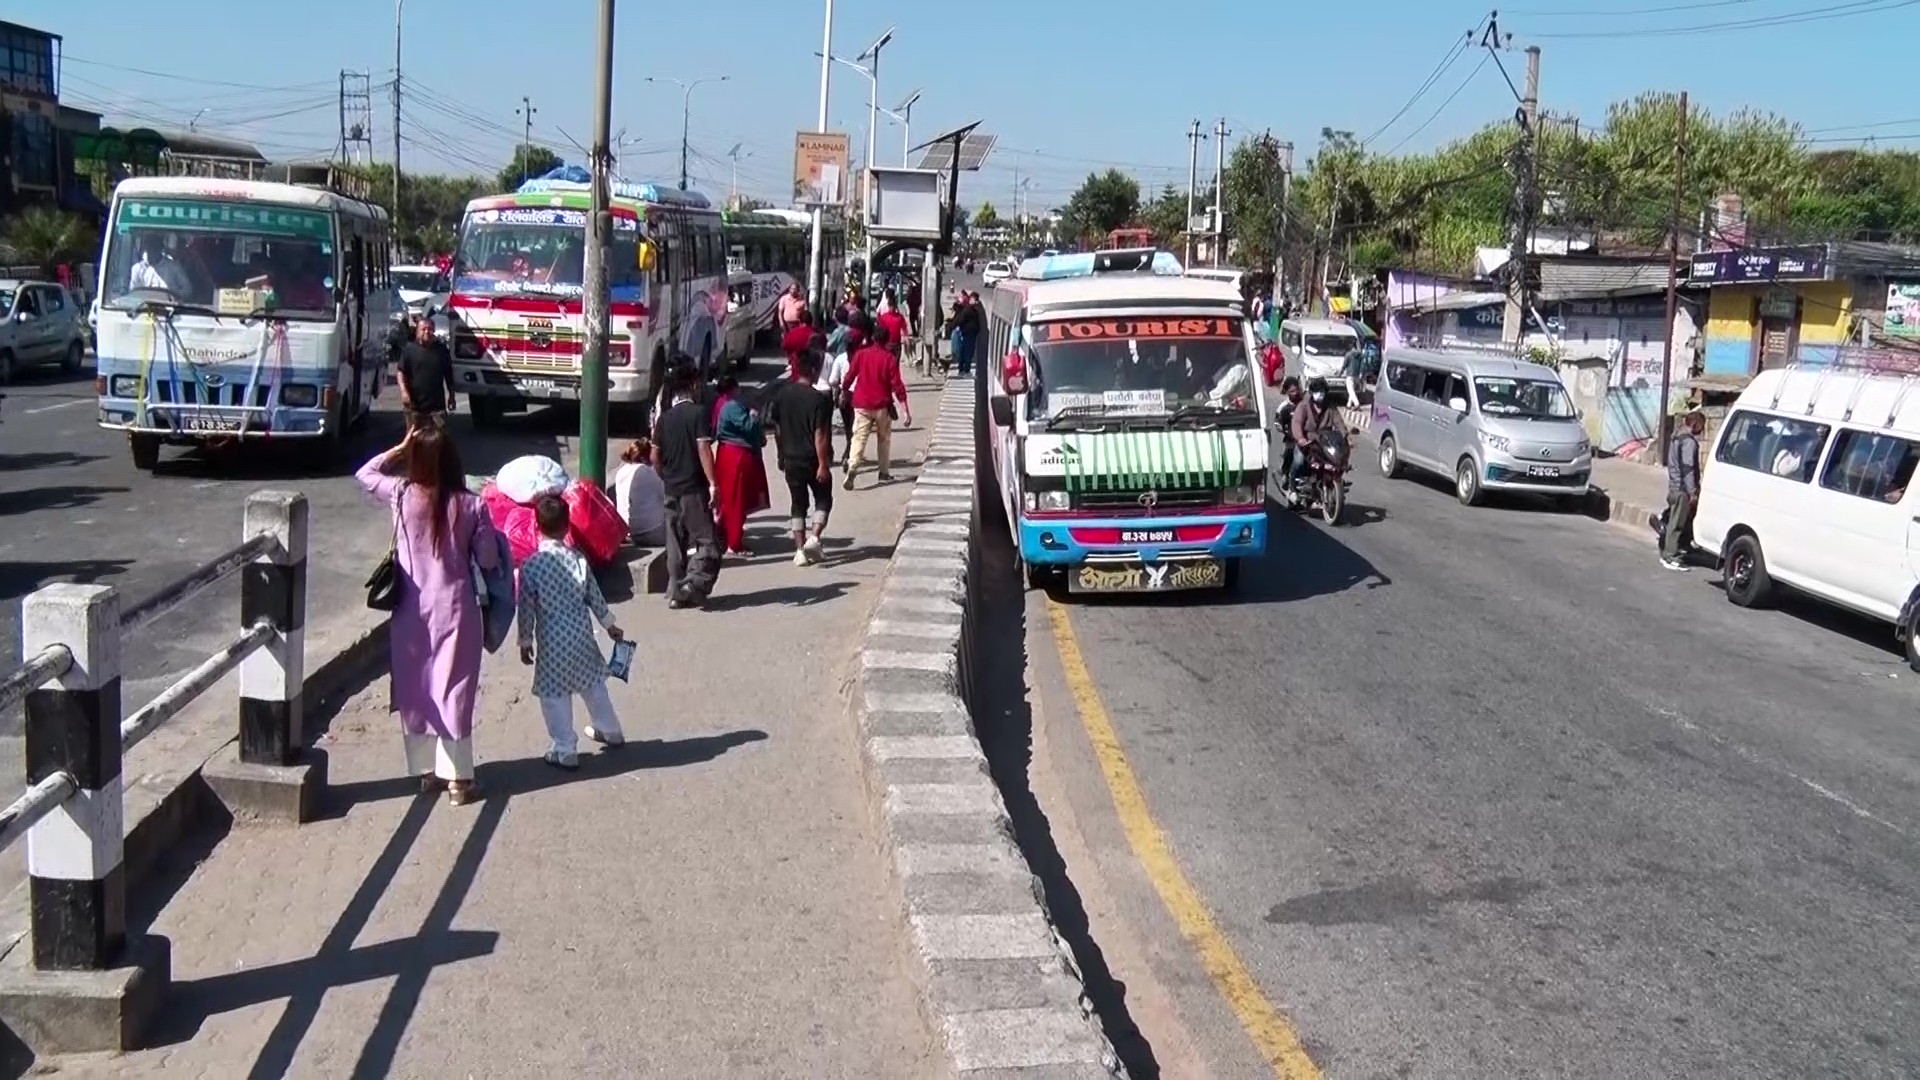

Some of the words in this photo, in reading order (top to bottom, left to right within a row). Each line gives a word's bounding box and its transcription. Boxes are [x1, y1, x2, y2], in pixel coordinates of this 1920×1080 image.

[128, 203, 323, 228] tourister
[1047, 319, 1231, 340] TOURIST
[1040, 456, 1082, 465] adidas
